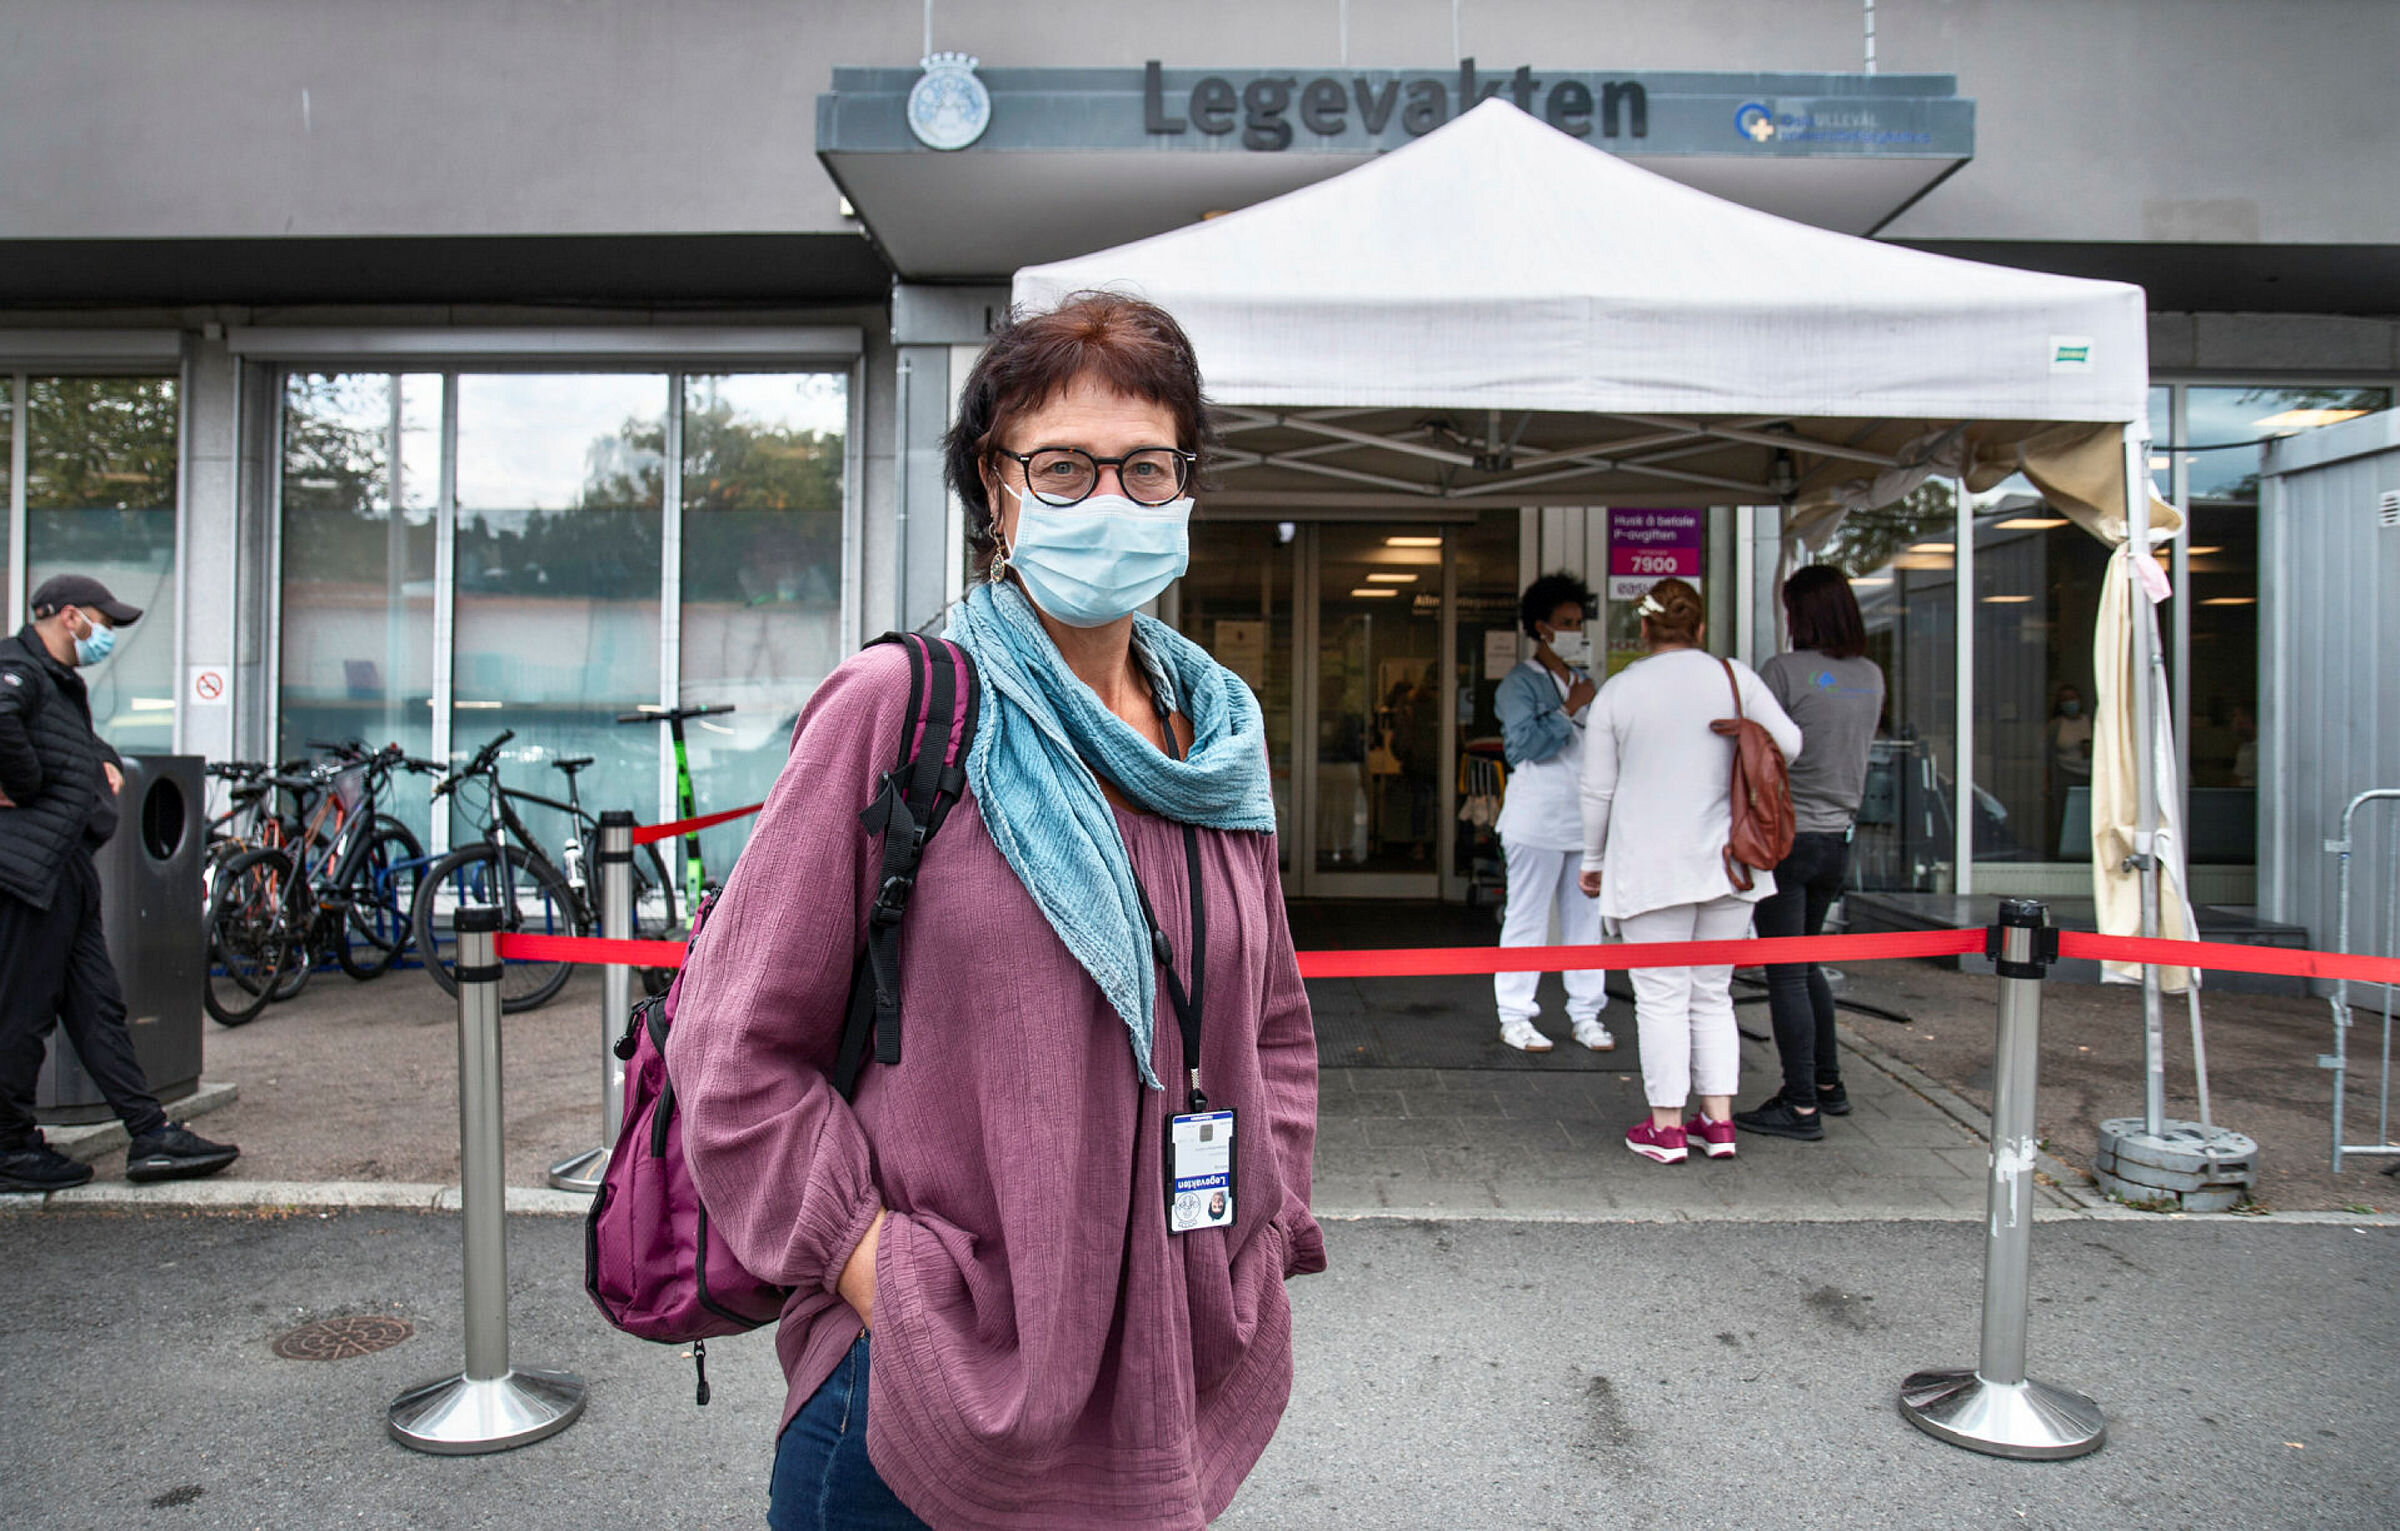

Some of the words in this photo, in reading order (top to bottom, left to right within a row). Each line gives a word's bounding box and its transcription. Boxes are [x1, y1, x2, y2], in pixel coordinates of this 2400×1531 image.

[1144, 57, 1648, 151] Legevakten
[1614, 514, 1642, 527] Husk
[1645, 513, 1656, 527] å
[1657, 514, 1696, 527] betale
[1613, 529, 1677, 544] P-avgiften
[1631, 555, 1678, 573] 7900
